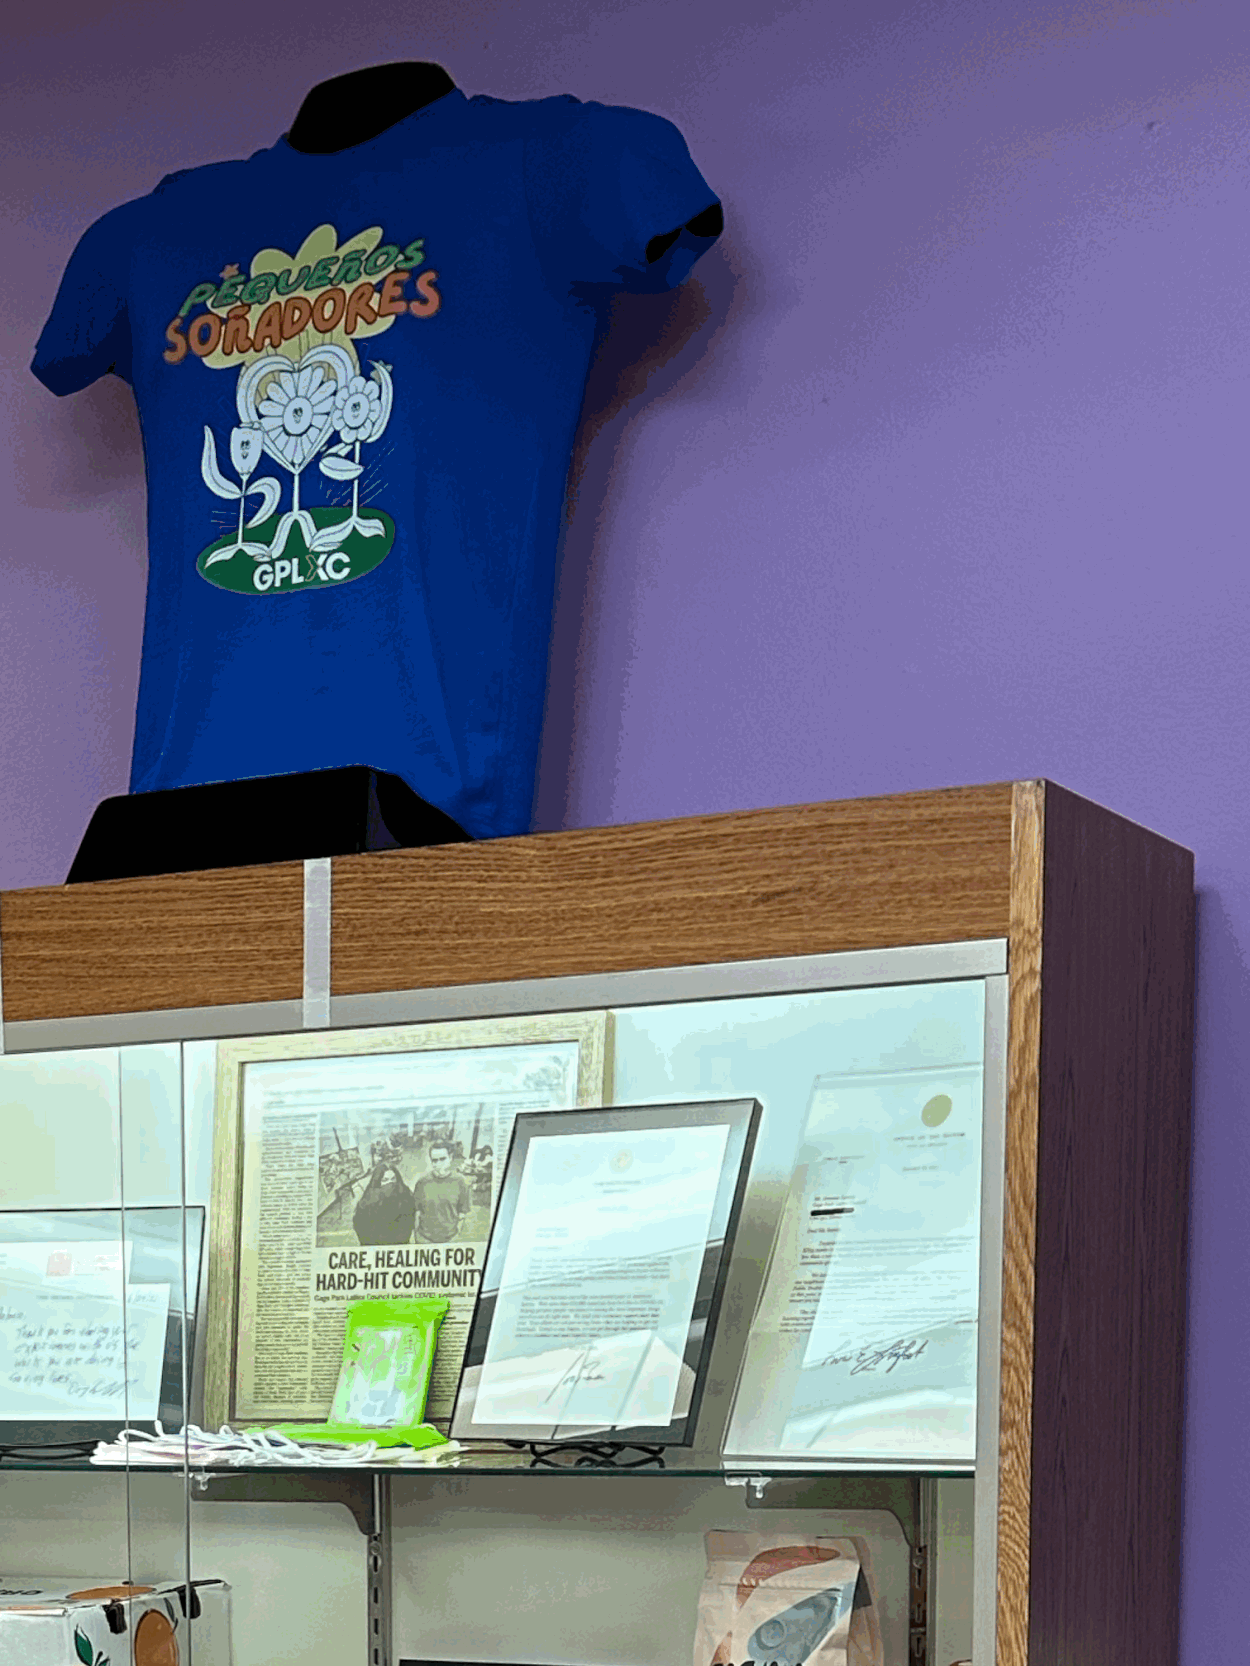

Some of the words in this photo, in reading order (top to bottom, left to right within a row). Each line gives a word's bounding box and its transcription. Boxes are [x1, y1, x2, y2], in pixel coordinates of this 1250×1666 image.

[179, 238, 425, 317] PEQUEÑOS
[162, 270, 441, 365] SOÑADORES
[252, 551, 351, 591] GPLXC
[328, 1251, 372, 1272] CARE,
[375, 1249, 441, 1270] HEALING
[445, 1247, 476, 1266] FOR
[316, 1271, 389, 1292] HARD-HIT
